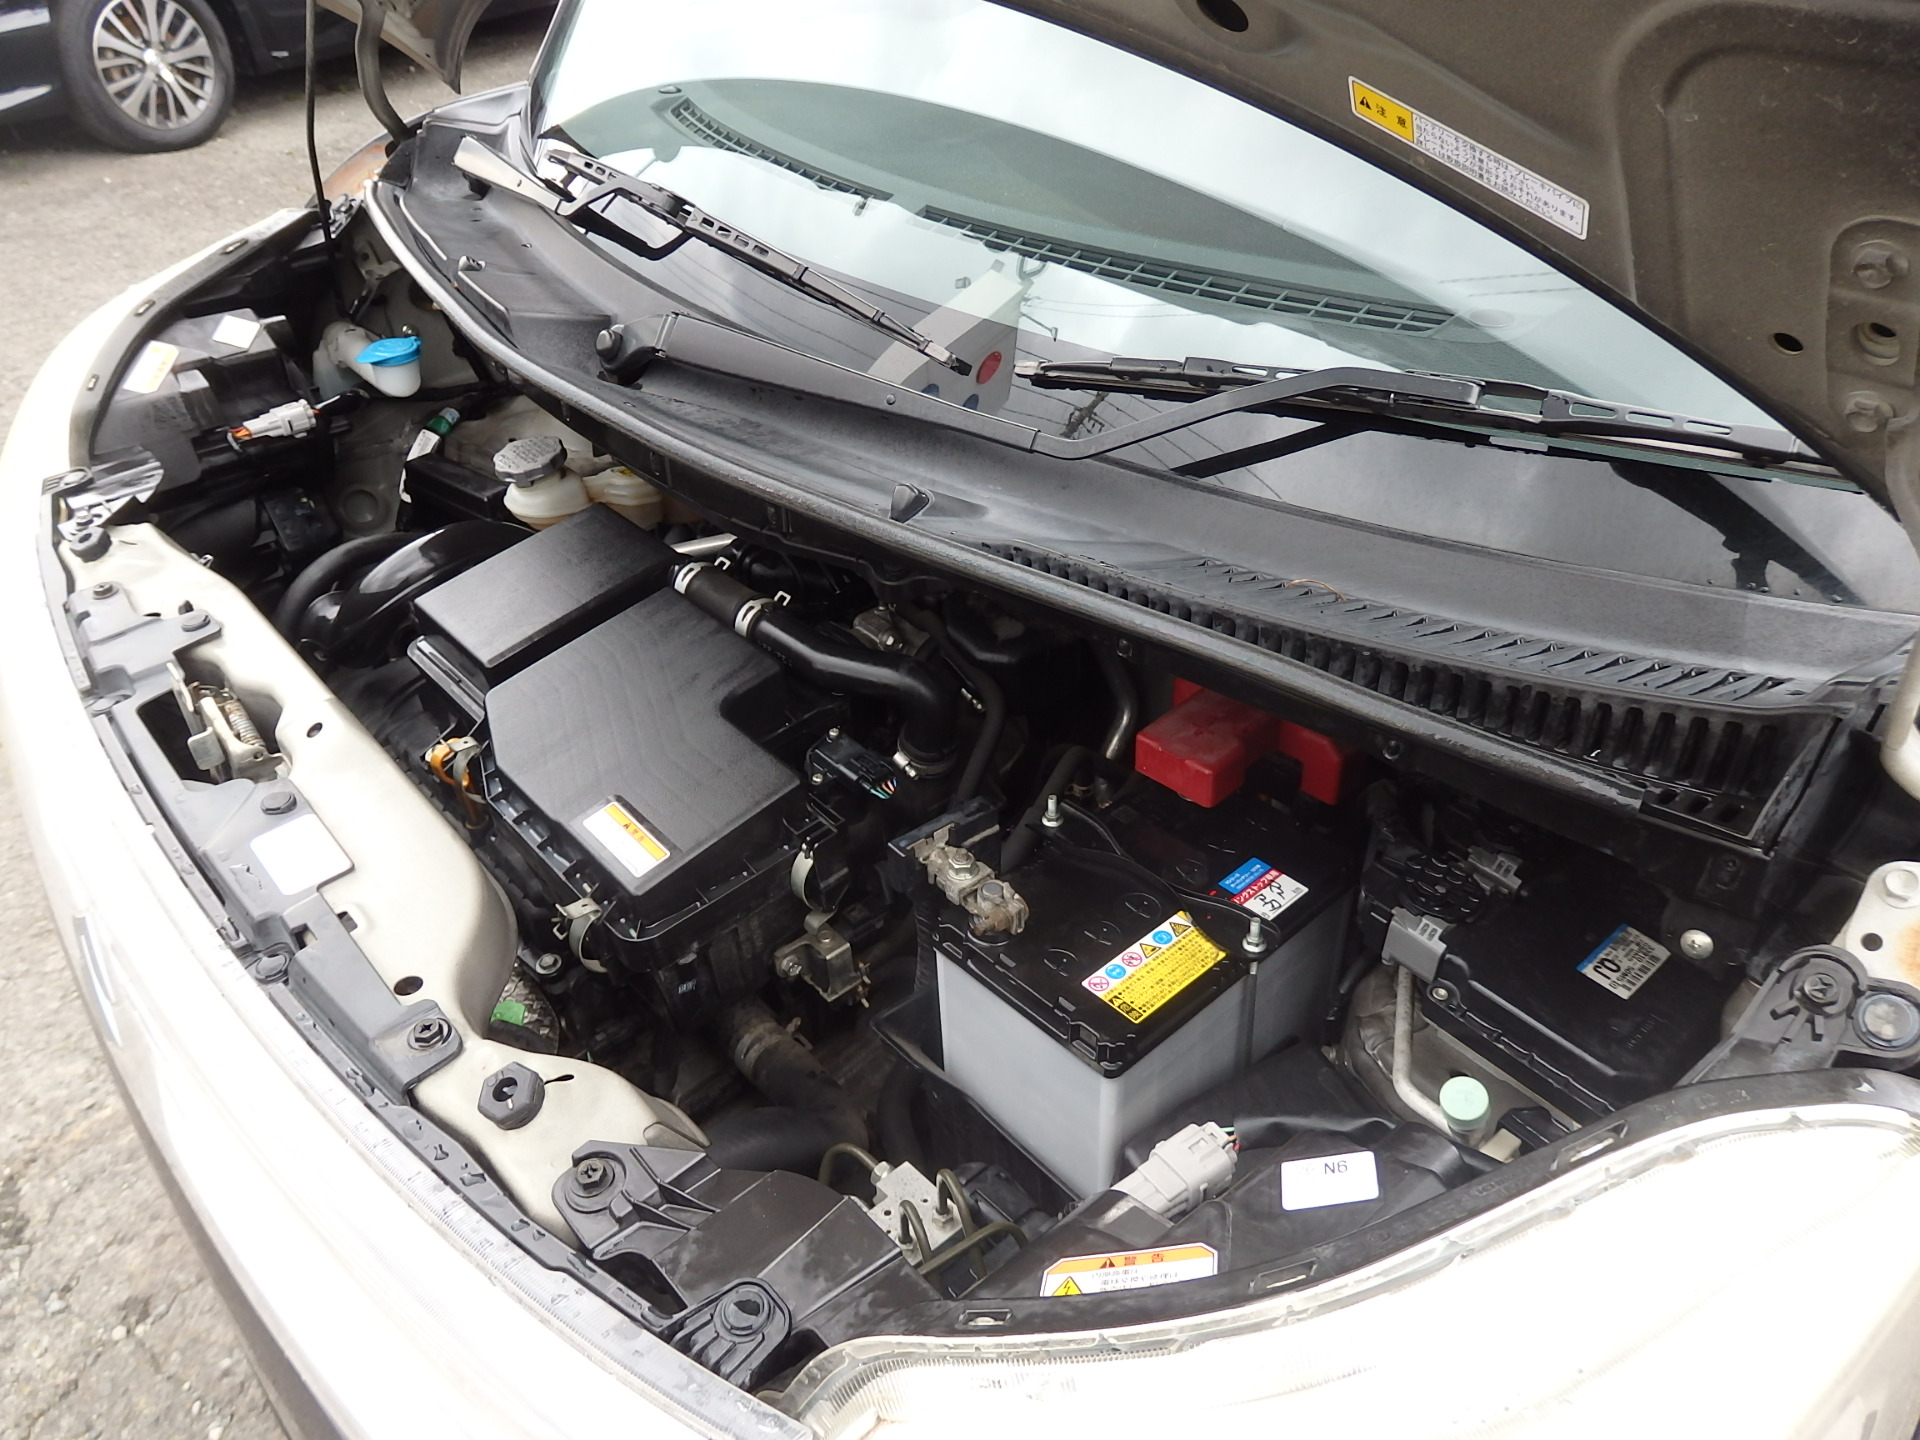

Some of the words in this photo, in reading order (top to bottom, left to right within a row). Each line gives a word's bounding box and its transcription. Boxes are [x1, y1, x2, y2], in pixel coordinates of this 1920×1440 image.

[1375, 103, 1408, 129] 注意
[1324, 1160, 1348, 1175] N6
[1124, 1253, 1165, 1266] 警告
